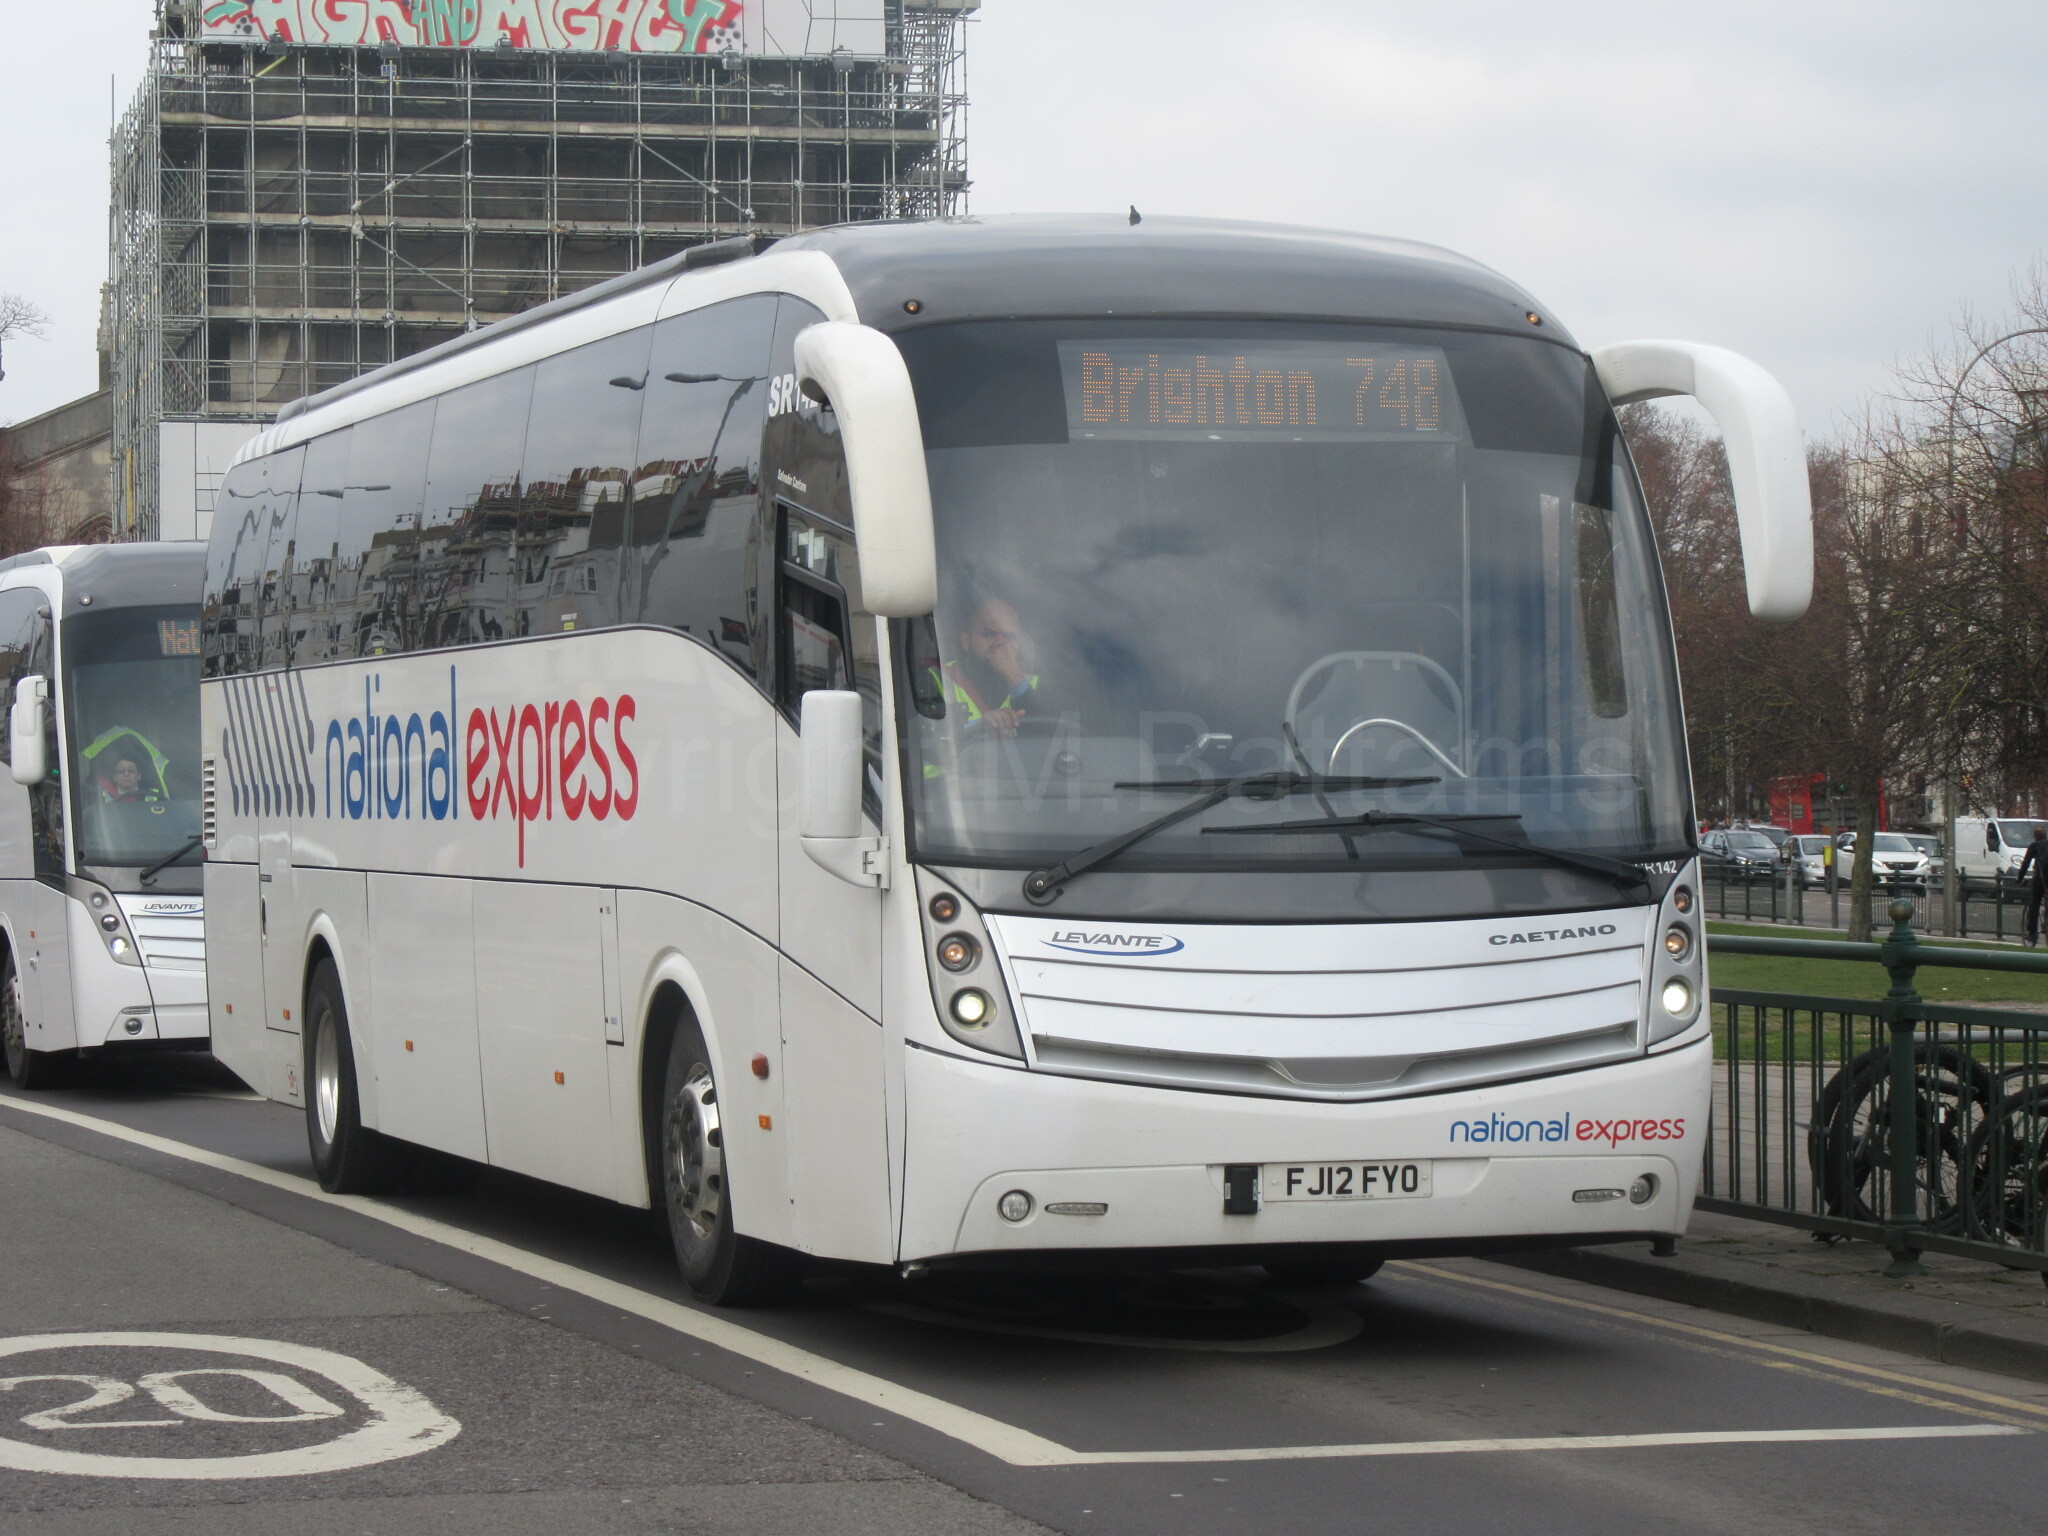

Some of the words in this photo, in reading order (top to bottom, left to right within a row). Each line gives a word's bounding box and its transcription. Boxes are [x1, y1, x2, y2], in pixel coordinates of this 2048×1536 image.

[1082, 352, 1317, 425] Brighton
[325, 664, 458, 821] national
[466, 693, 639, 869] express
[1634, 860, 1678, 875] R142
[144, 903, 198, 911] LEVANTE
[1051, 931, 1163, 948] LEVANTE
[1488, 923, 1617, 946] CAETANO
[1449, 1111, 1570, 1143] national
[1575, 1118, 1685, 1149] express
[1286, 1166, 1353, 1196] FJ12
[1362, 1164, 1418, 1194] FYO
[0, 1367, 346, 1430] 20
